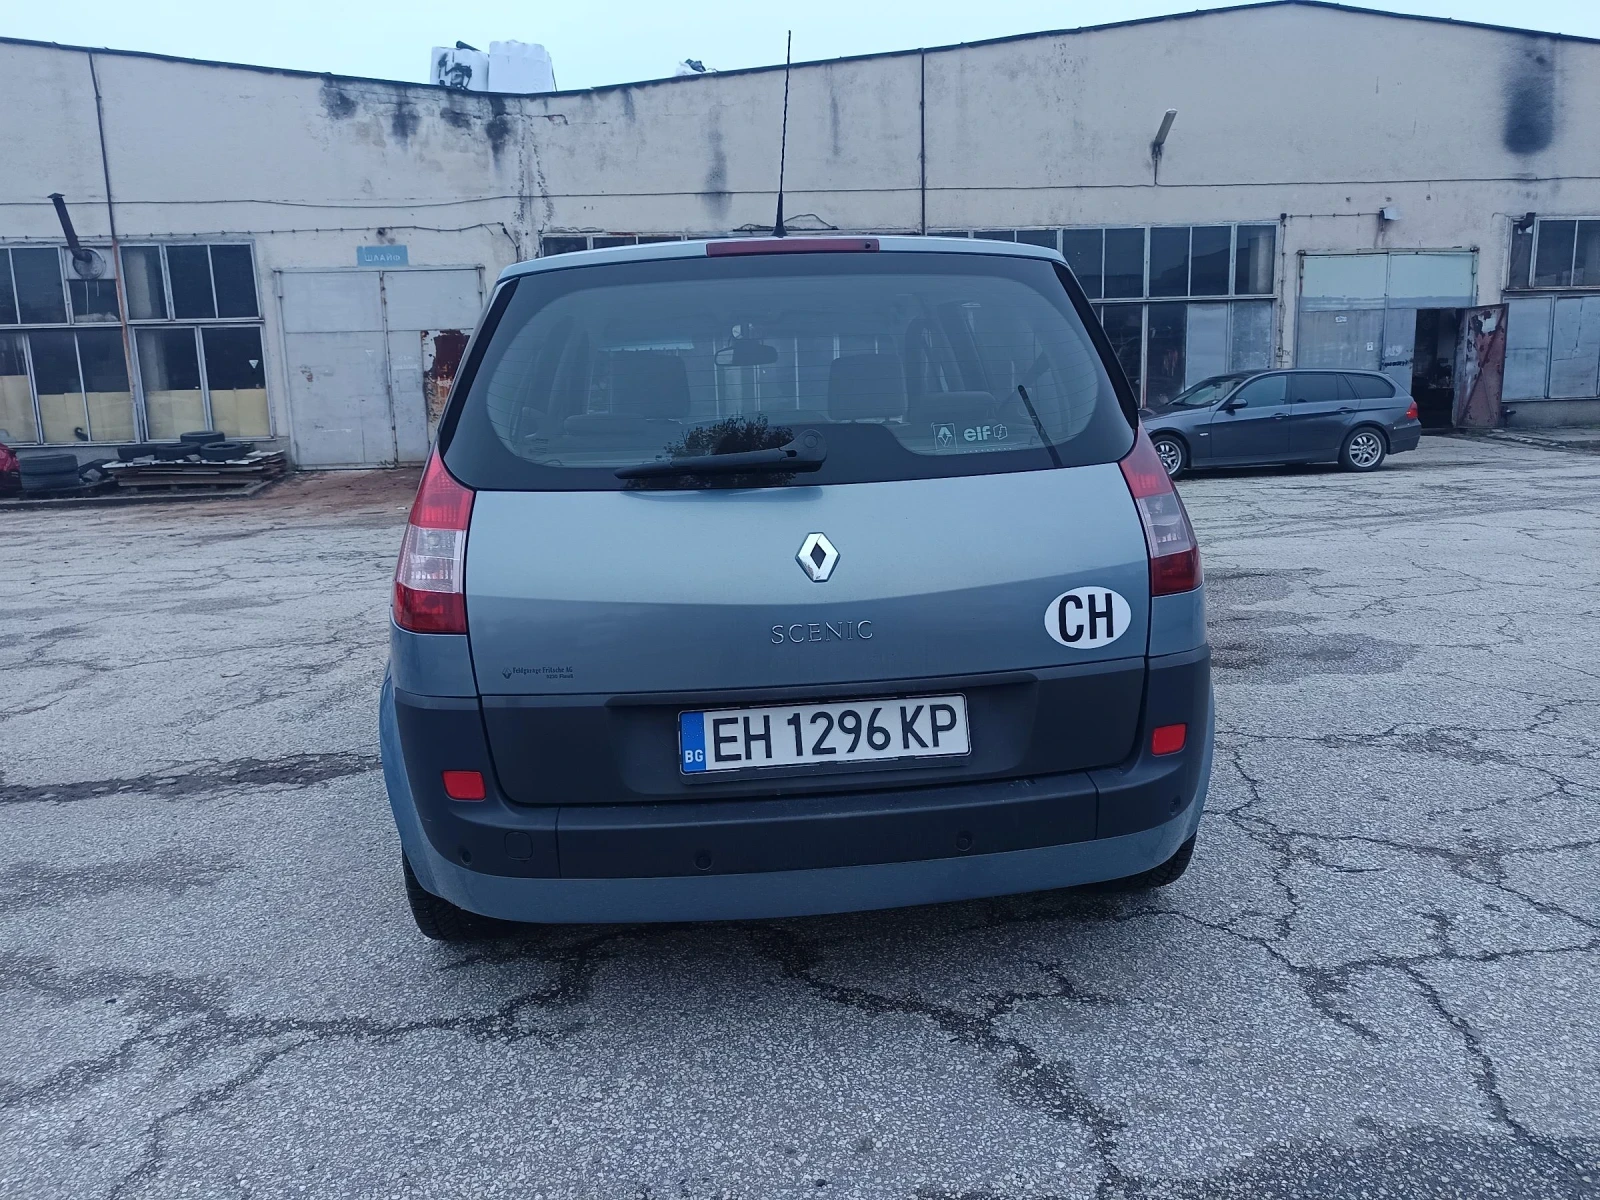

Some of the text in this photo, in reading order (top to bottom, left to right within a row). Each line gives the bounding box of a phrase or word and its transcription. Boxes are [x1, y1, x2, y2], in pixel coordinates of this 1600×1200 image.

[364, 252, 401, 262] ШЛАЙФ
[963, 425, 991, 442] elf
[1058, 593, 1114, 643] CH
[770, 620, 874, 645] SCENIC
[712, 704, 957, 763] EH 1296 KP
[684, 749, 704, 764] BG
